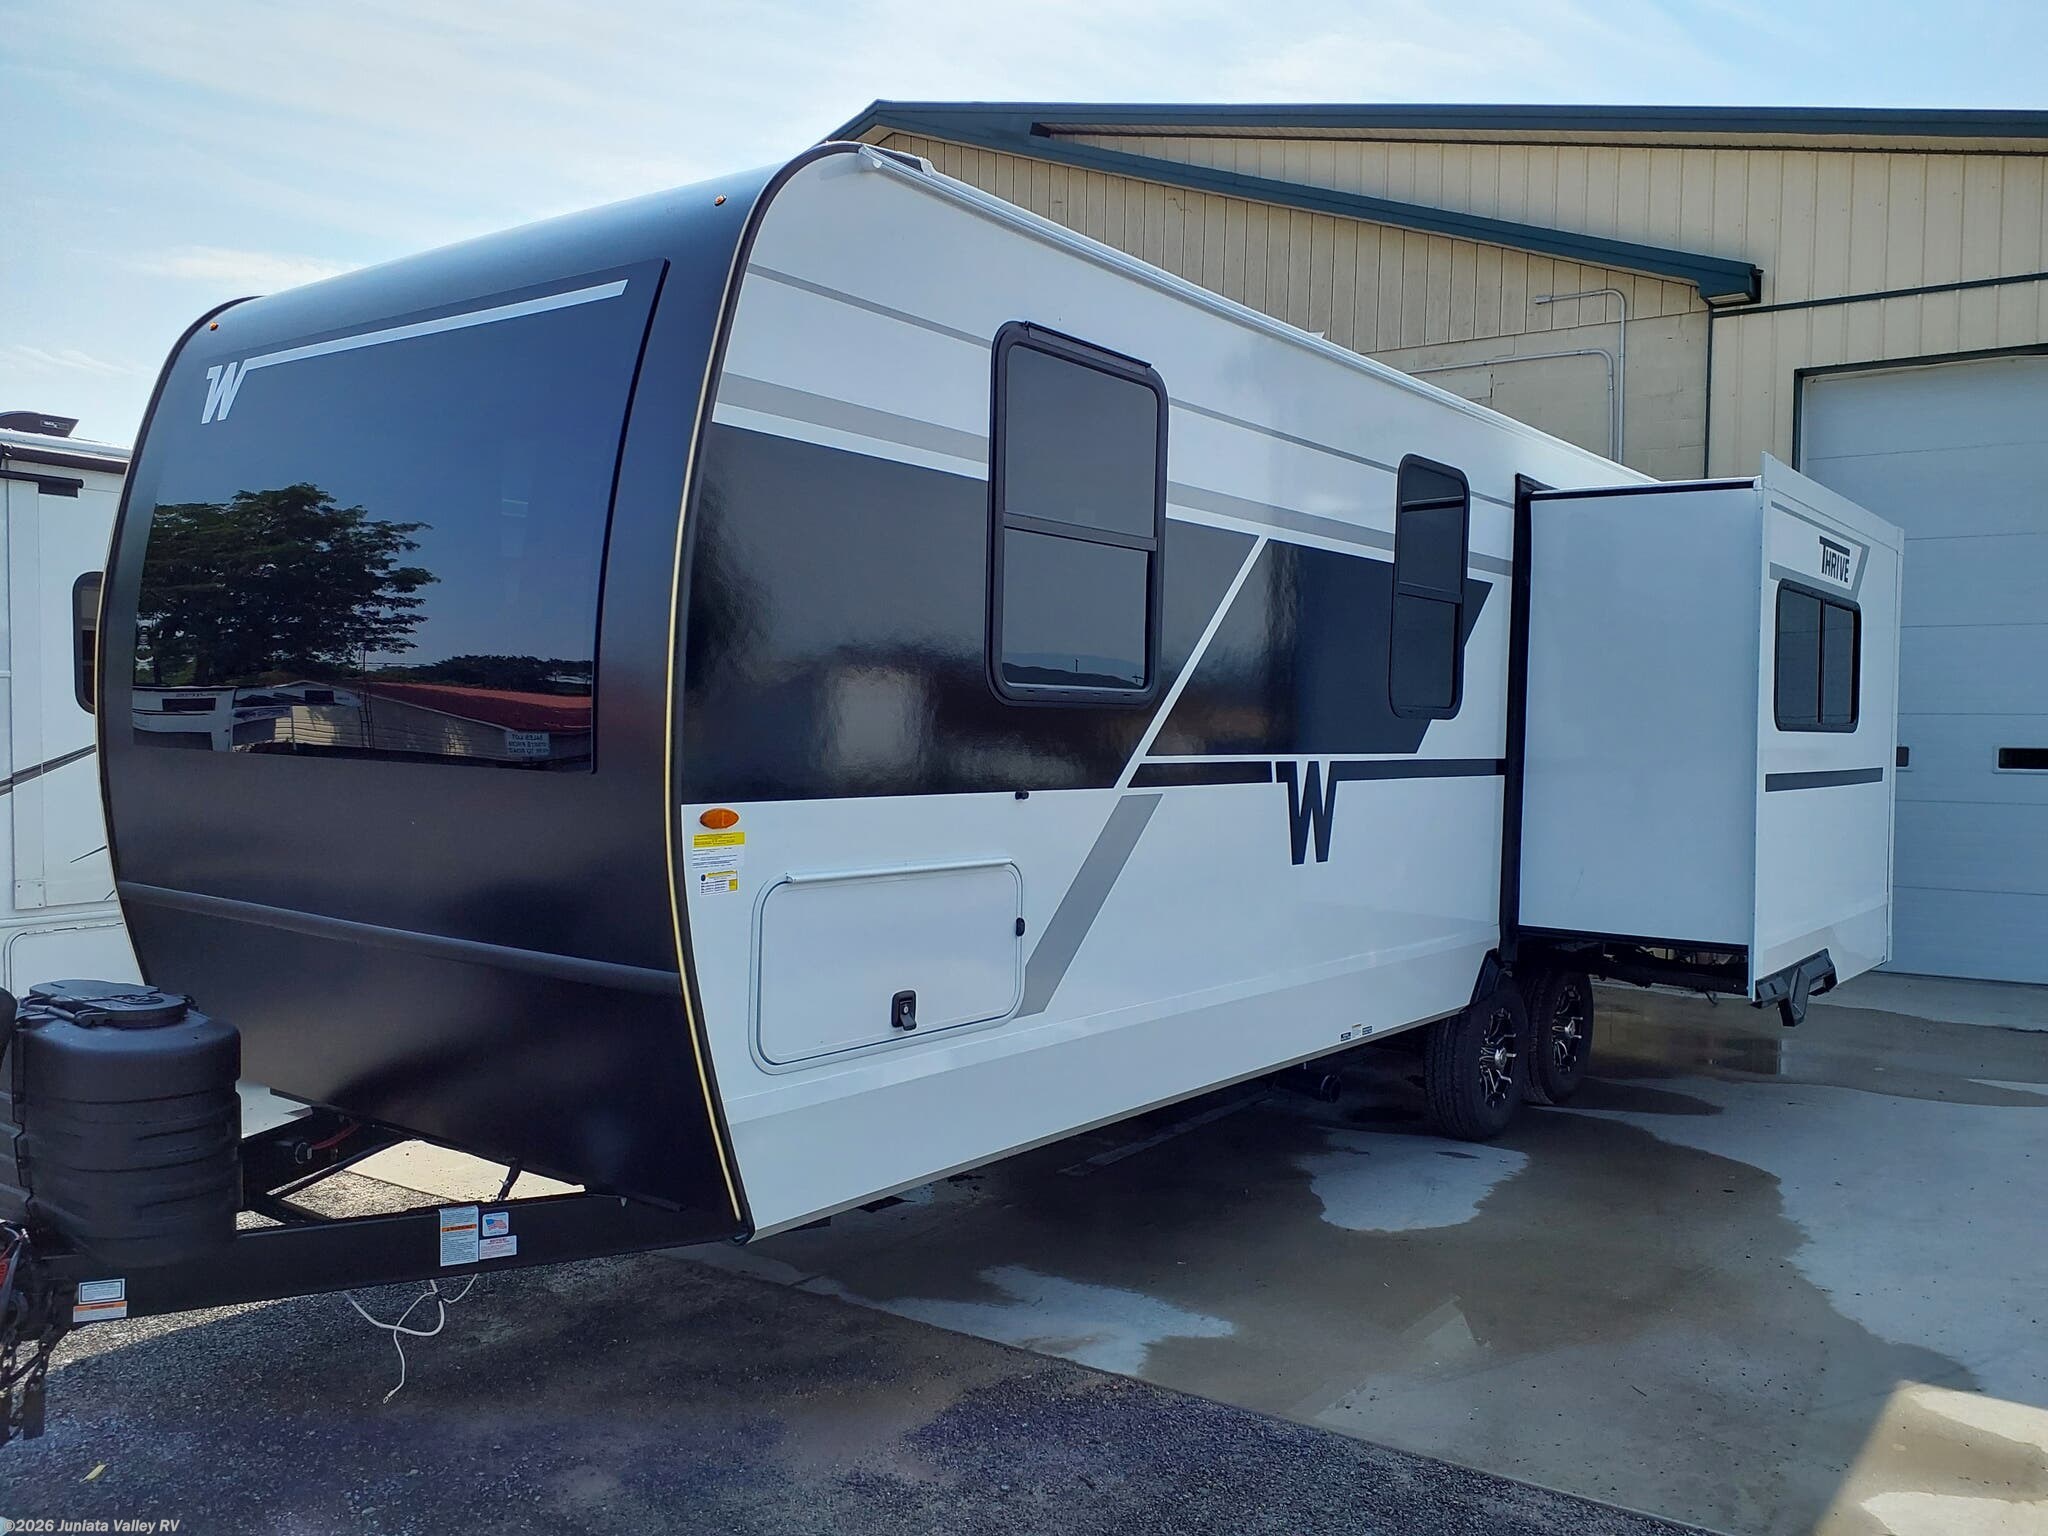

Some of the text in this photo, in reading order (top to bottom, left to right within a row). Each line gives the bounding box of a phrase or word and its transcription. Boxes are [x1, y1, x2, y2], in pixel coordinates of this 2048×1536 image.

[202, 360, 247, 424] W
[1819, 535, 1850, 583] THRIVE
[1276, 761, 1338, 865] W
